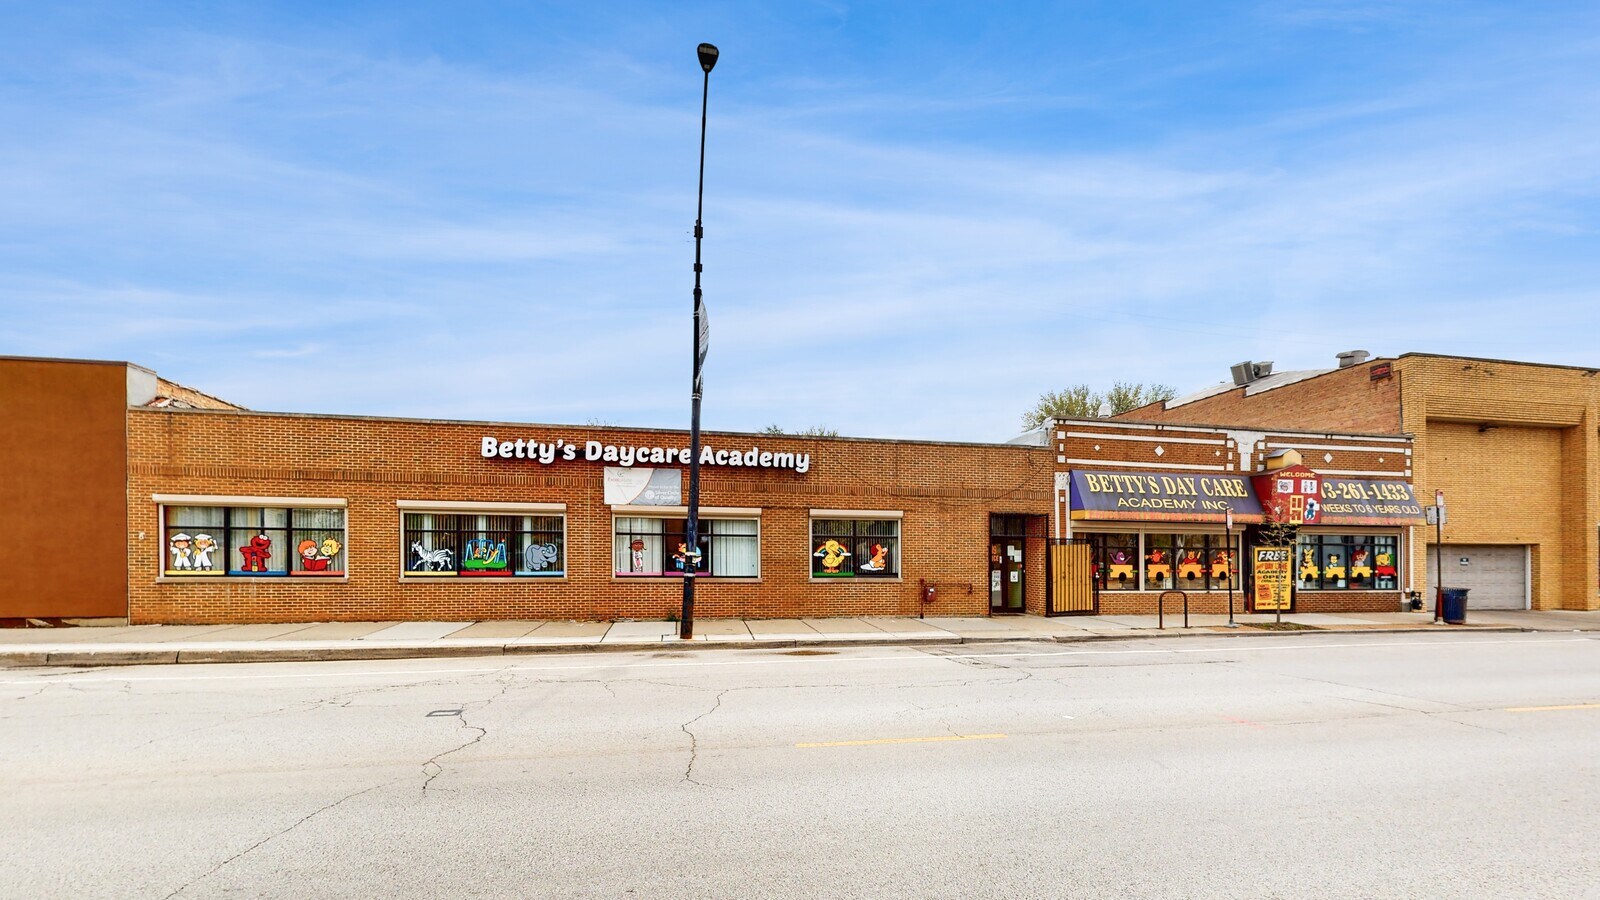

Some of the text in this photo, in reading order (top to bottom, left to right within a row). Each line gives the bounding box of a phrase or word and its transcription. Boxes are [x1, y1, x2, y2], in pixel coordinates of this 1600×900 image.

[481, 436, 810, 473] Betty's Daycare Academy
[1085, 473, 1248, 498] BETTY'S DAY CARE
[1117, 497, 1197, 509] ACADEMY
[1321, 503, 1353, 513] WEEKS
[1353, 504, 1366, 513] TO
[1372, 504, 1402, 514] YEARS
[1402, 505, 1420, 515] OLD
[1258, 550, 1288, 561] FREE
